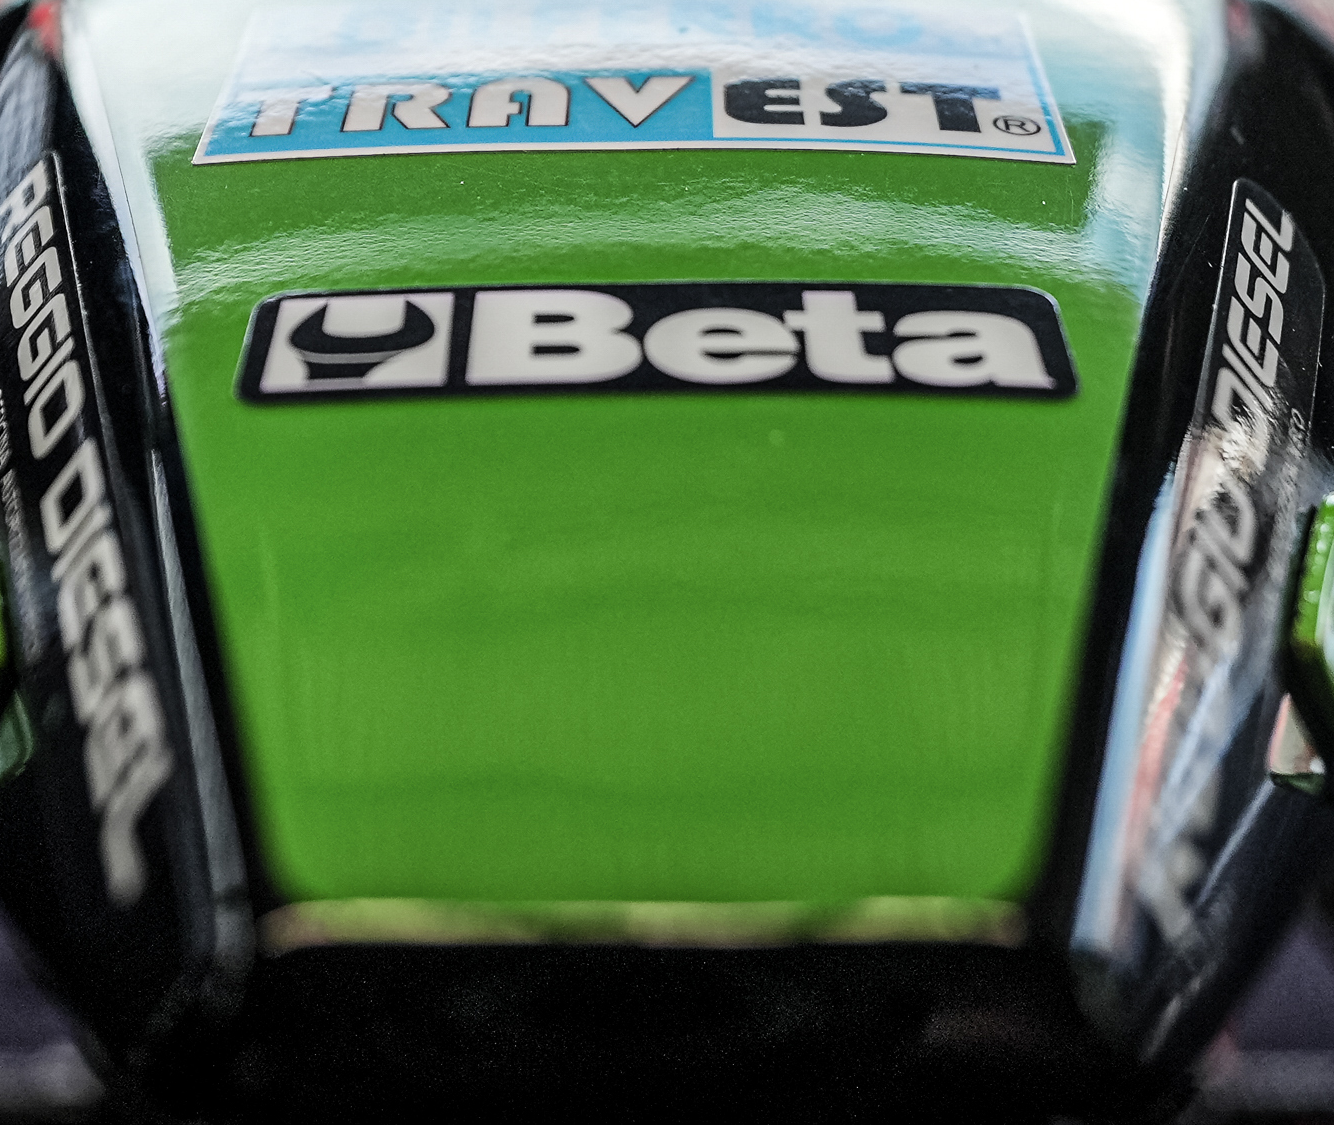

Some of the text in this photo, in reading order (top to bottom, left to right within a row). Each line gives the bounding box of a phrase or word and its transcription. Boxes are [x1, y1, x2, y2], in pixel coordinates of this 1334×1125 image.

[0, 159, 85, 463] REGGIO
[466, 291, 1056, 390] Beta
[40, 436, 174, 908] DIESEL
